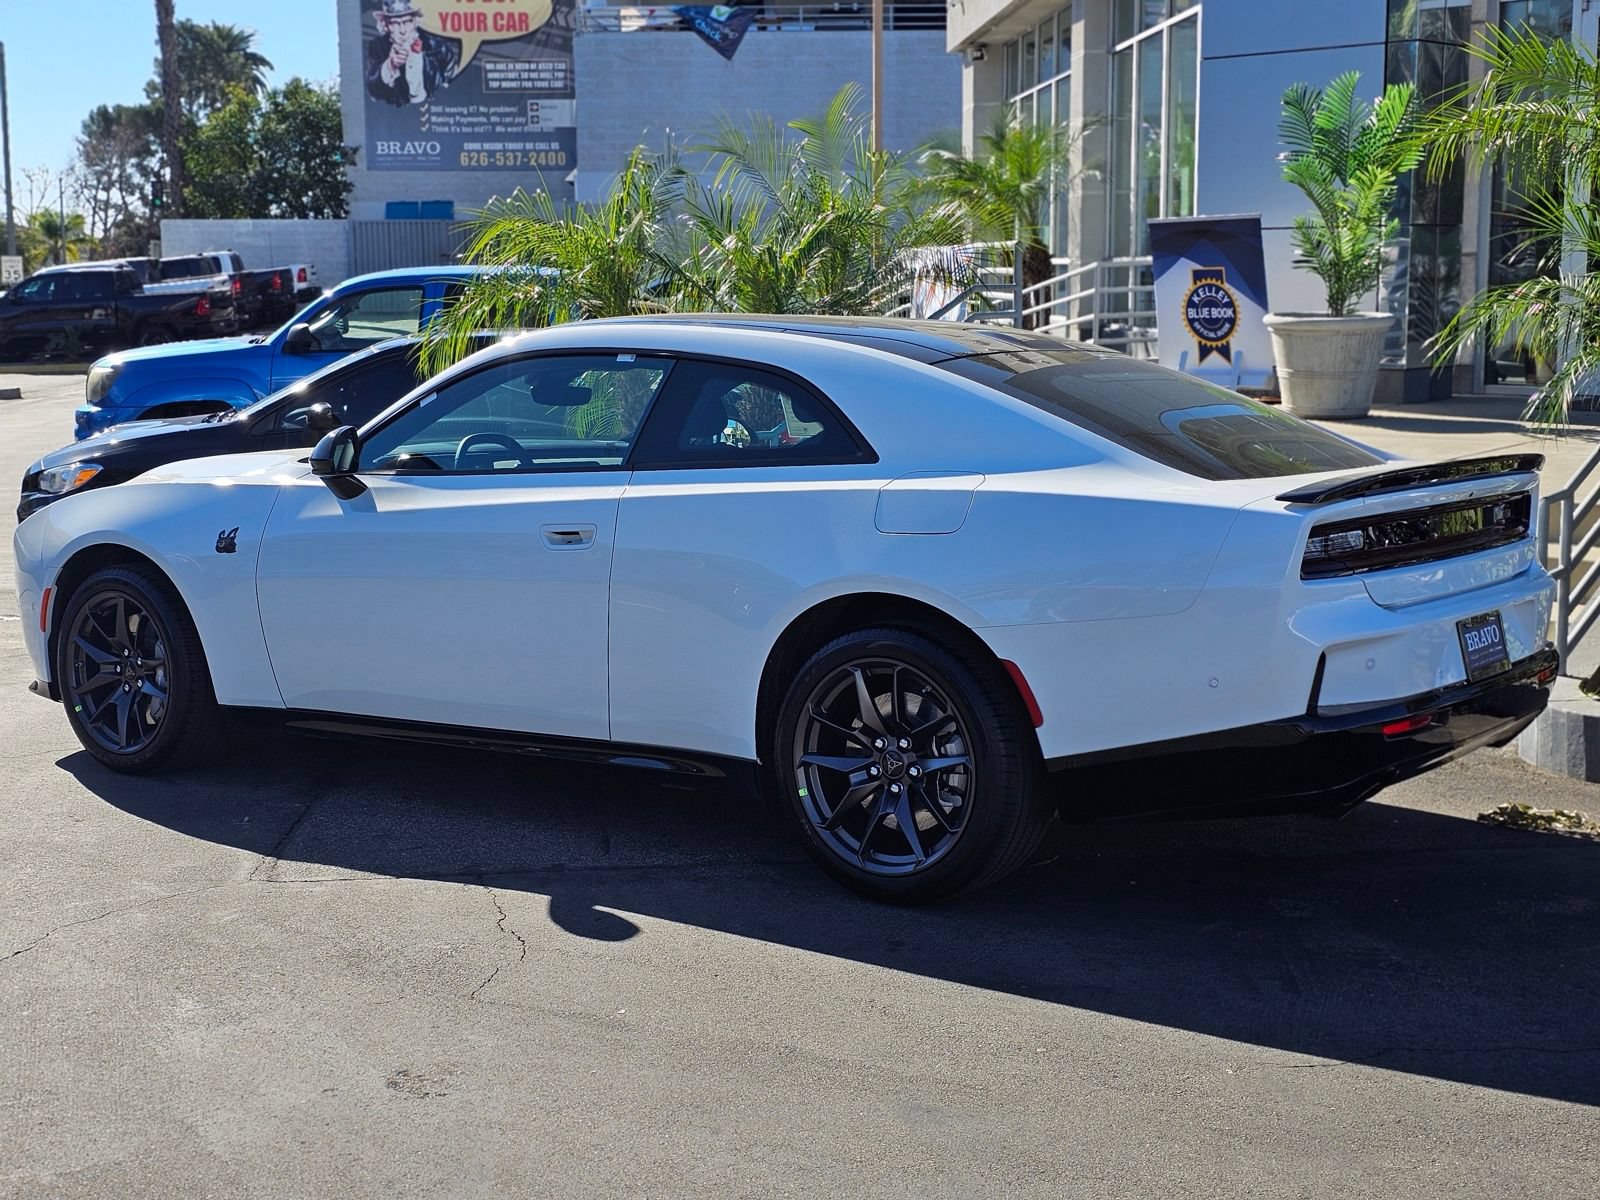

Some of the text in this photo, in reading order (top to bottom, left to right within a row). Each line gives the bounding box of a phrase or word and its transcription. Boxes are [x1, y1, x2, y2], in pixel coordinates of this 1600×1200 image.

[438, 12, 529, 32] YOUR CAR
[515, 62, 529, 70] NEED
[538, 62, 553, 70] USED
[554, 62, 566, 70] CAR
[444, 106, 467, 114] leasing
[431, 116, 454, 124] Making
[376, 141, 440, 154] BRAVO
[463, 142, 560, 150] COME INSIDE TODAY OR CALL US
[460, 152, 566, 166] 626-537-2400
[4, 270, 21, 280] 35
[1192, 286, 1230, 304] KELLEY
[1188, 307, 1234, 318] BLUE BOOK
[1193, 322, 1217, 338] OFFICIAL
[1465, 625, 1499, 651] BRAVO
